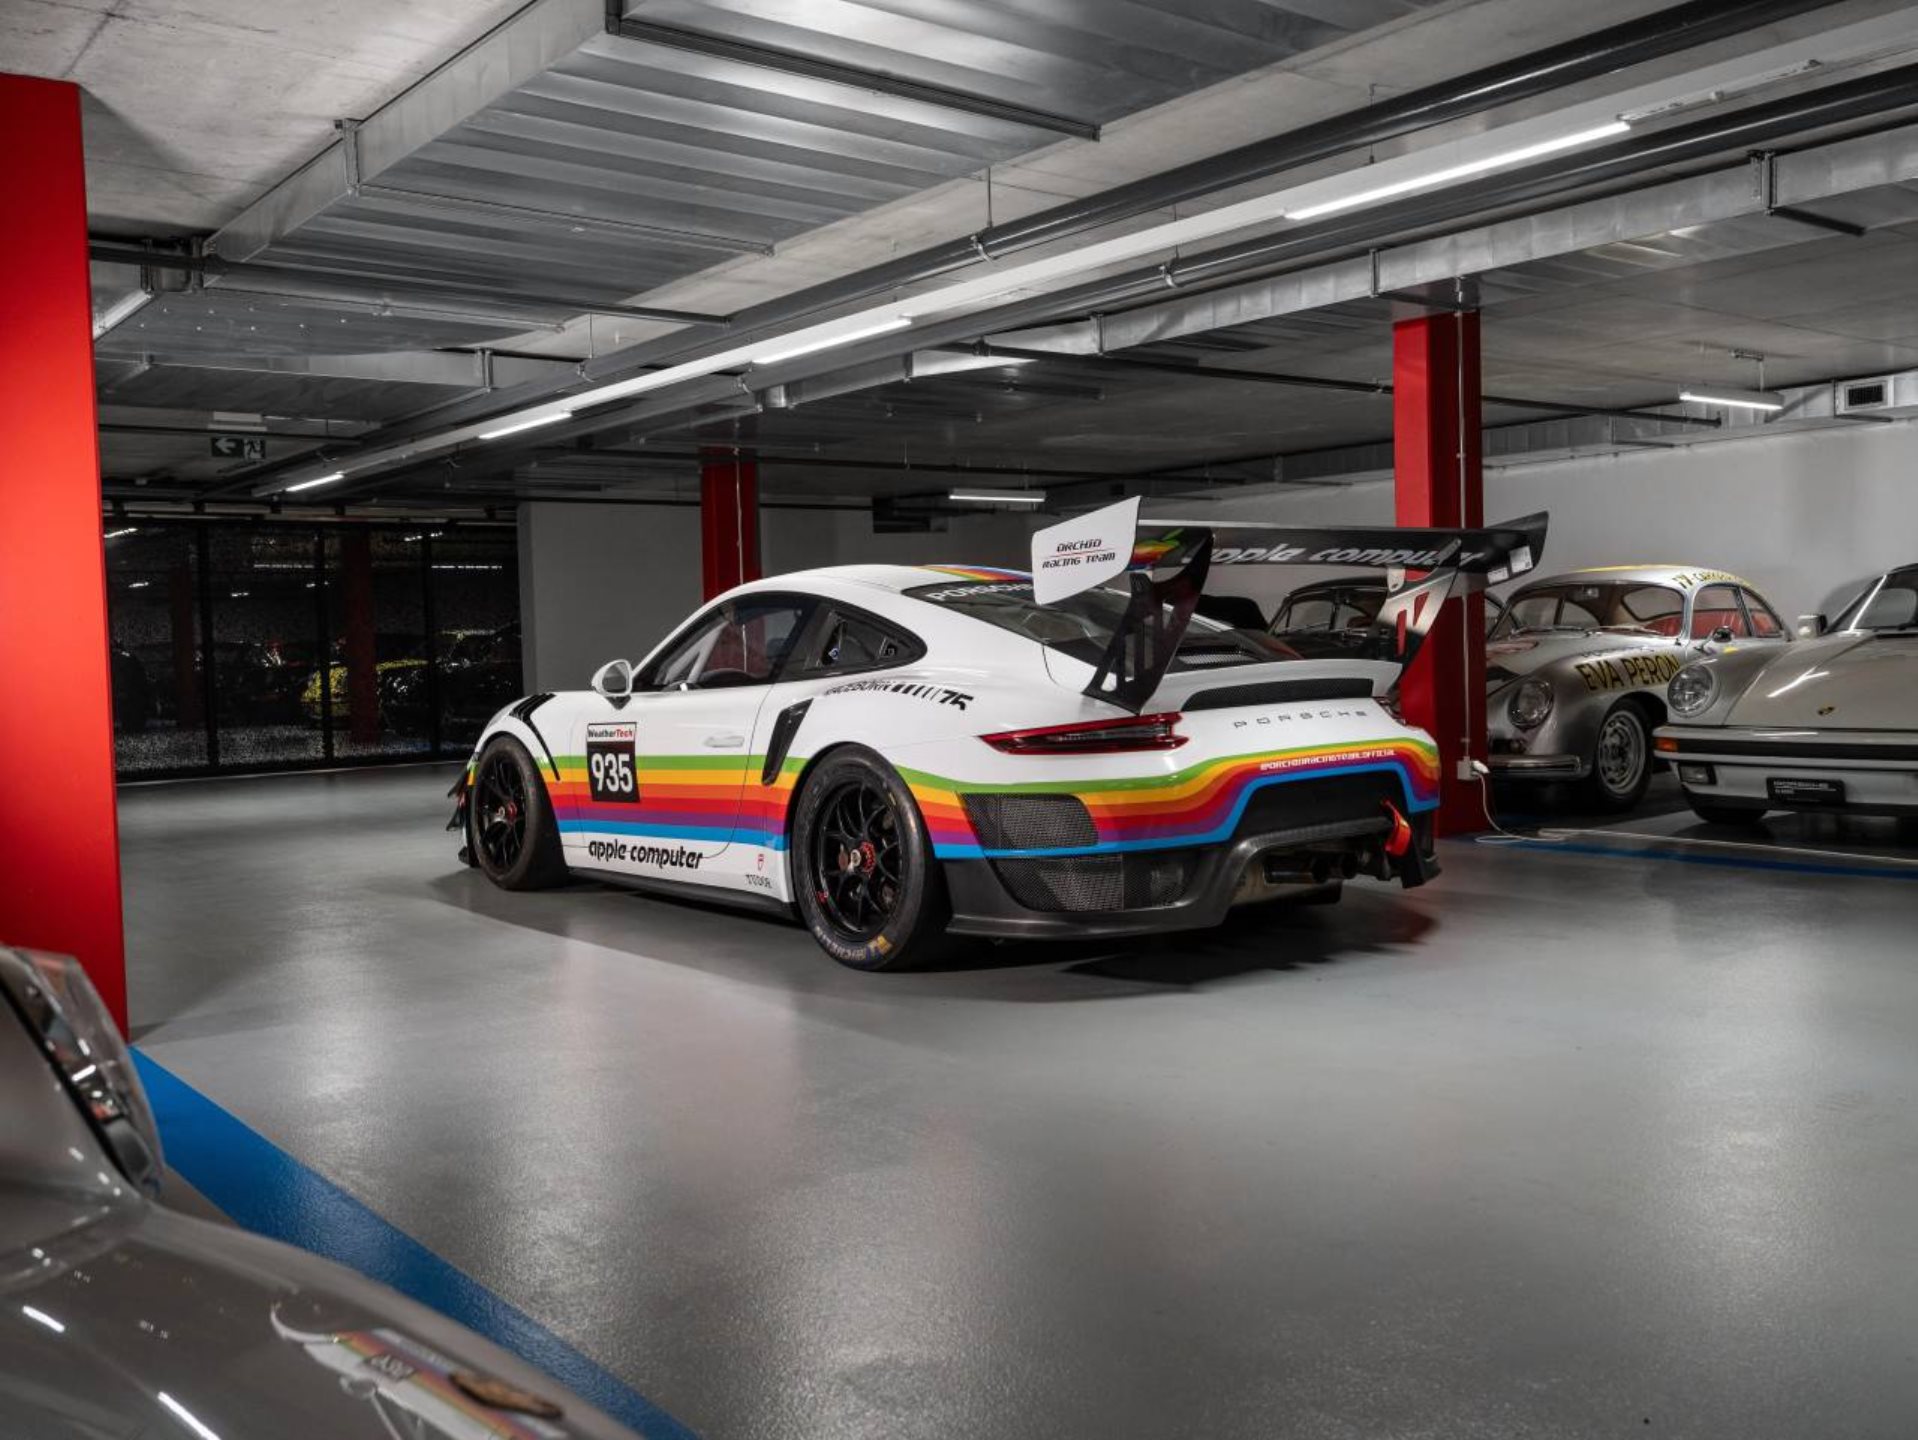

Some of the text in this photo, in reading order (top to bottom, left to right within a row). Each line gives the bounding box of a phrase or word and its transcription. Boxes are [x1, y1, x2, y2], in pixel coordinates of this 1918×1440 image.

[1056, 538, 1102, 552] ORCHID
[1182, 543, 1485, 567] pple compur
[1574, 654, 1680, 691] EVA PERON
[938, 689, 974, 711] 75
[1233, 710, 1368, 729] PORSCHE
[588, 728, 633, 739] WeatherTech
[591, 753, 633, 793] 935
[588, 839, 703, 870] apple computer
